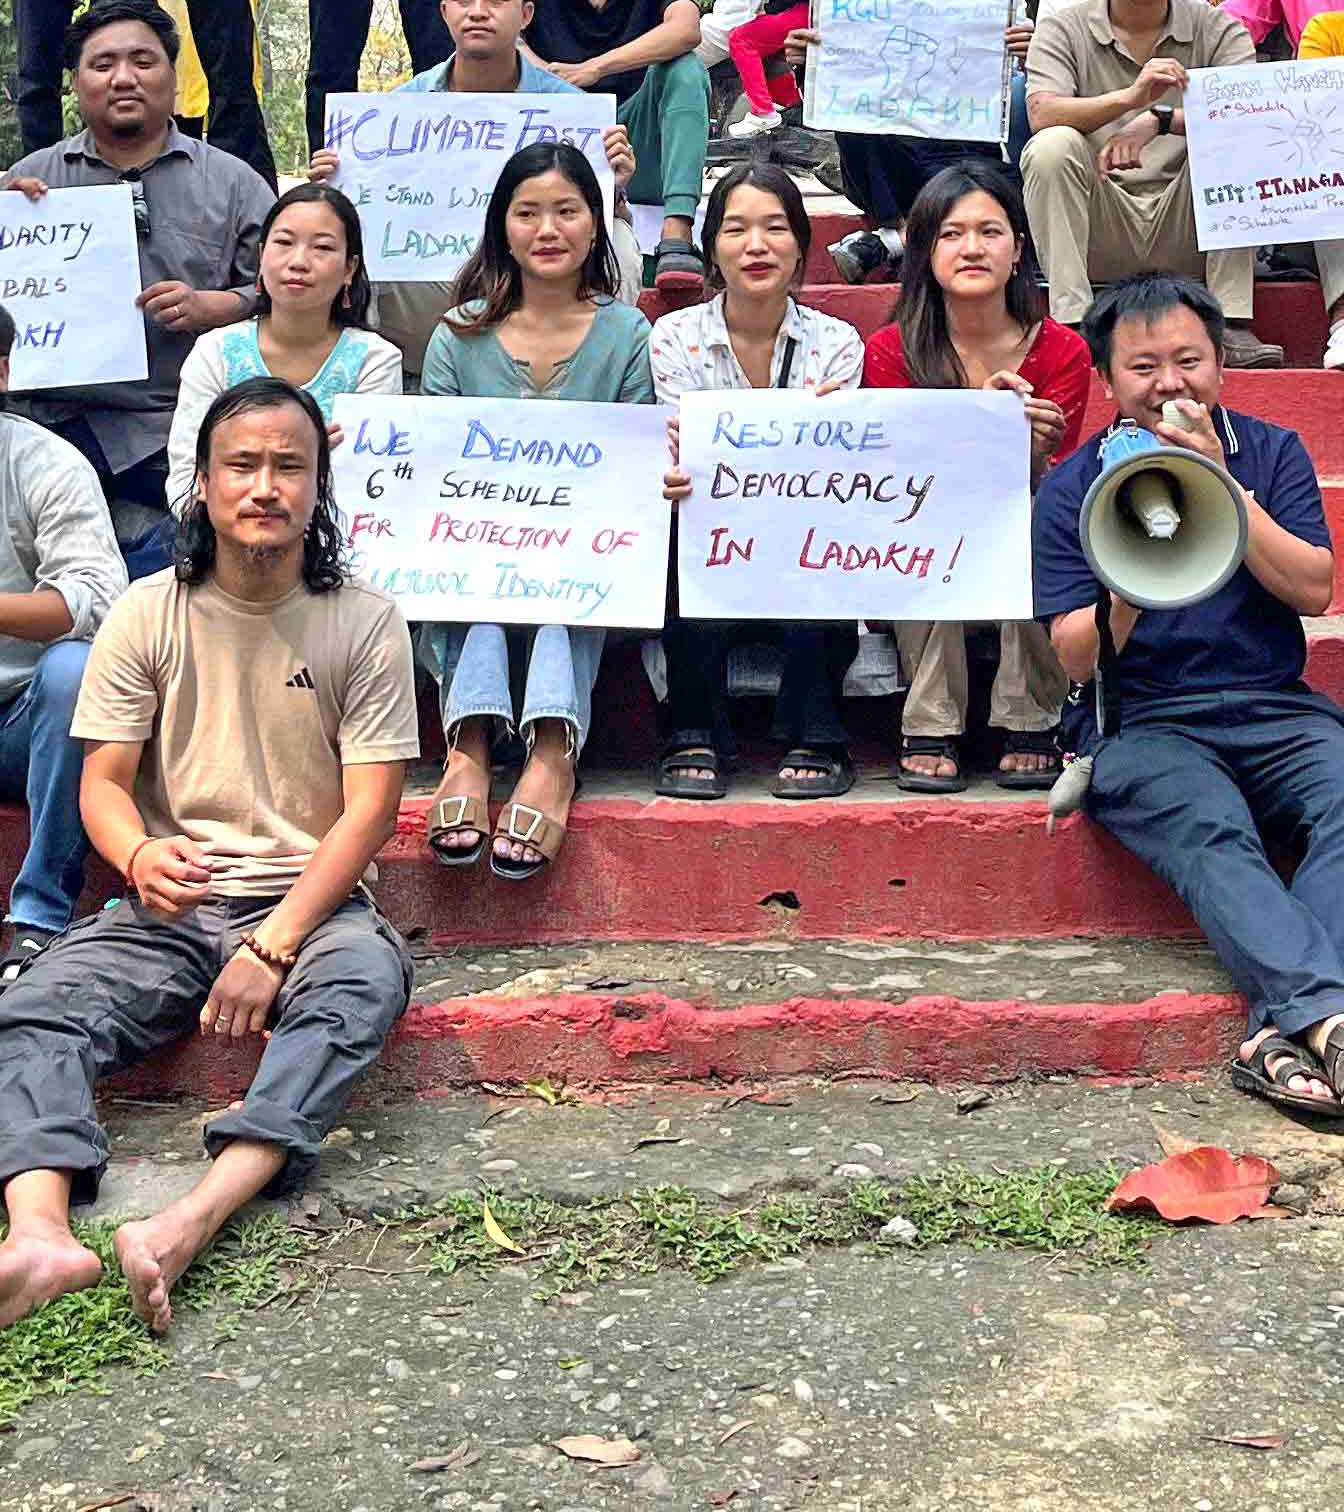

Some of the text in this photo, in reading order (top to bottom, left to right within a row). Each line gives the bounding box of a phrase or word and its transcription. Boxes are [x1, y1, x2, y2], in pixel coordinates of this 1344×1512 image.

[326, 108, 509, 161] #CLIMATE
[385, 184, 435, 206] STAND
[449, 187, 494, 208] WIT
[381, 220, 477, 259] LADAK
[353, 418, 603, 468] WE DEMAND
[712, 410, 892, 452] RESTORE
[366, 461, 573, 507] 6th SCHEDULE
[710, 462, 935, 523] DEMOCRACY
[429, 511, 572, 551] PROTECTION
[591, 528, 639, 554] OF
[706, 527, 754, 567] IN
